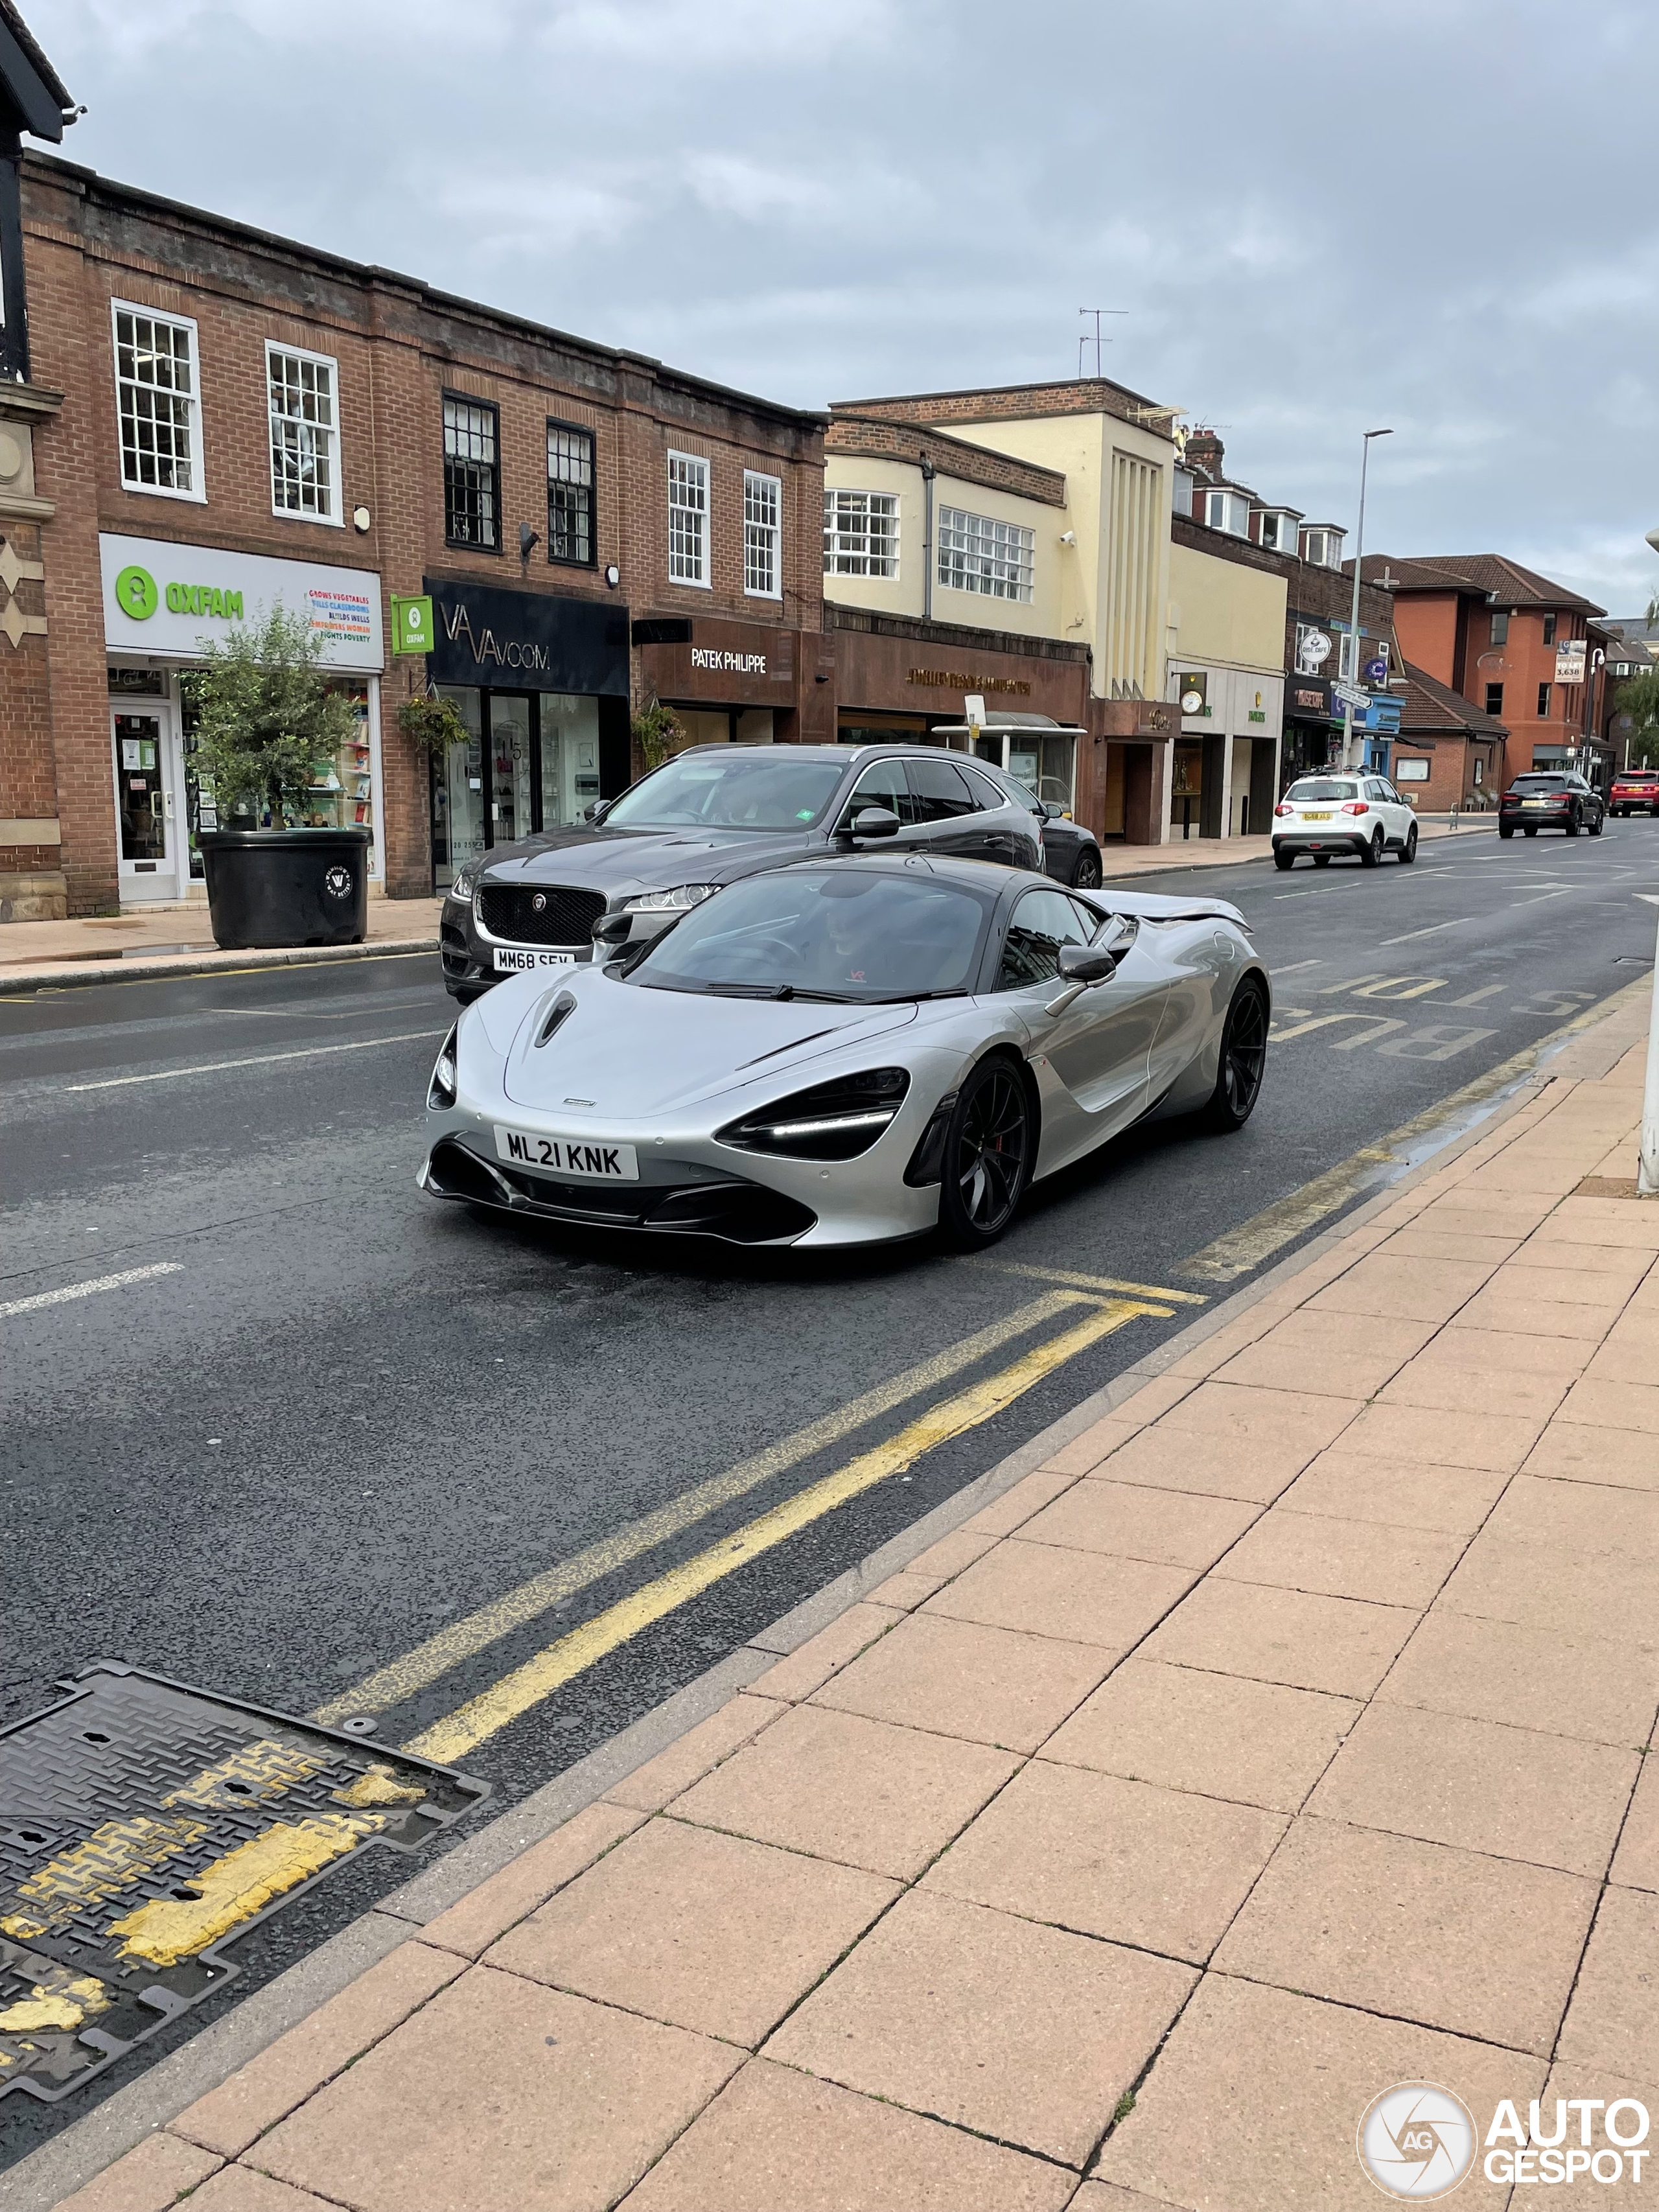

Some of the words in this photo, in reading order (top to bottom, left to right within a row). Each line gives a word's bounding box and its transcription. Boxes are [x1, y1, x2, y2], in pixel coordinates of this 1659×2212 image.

[166, 582, 244, 620] OXFAM
[309, 590, 332, 600] GROWS
[333, 592, 369, 604] VEGETABLES
[330, 601, 369, 614] CLASSROOMS
[351, 614, 370, 623] WELLS
[346, 624, 371, 634] WOMEN
[343, 633, 371, 643] POVERTY
[406, 633, 426, 644] OXFAM
[691, 648, 723, 670] PATEK
[724, 651, 767, 674] PHILIPPE
[331, 874, 343, 887] W
[498, 951, 535, 969] MM68
[507, 1132, 561, 1167] ML21
[566, 1144, 622, 1174] KNK
